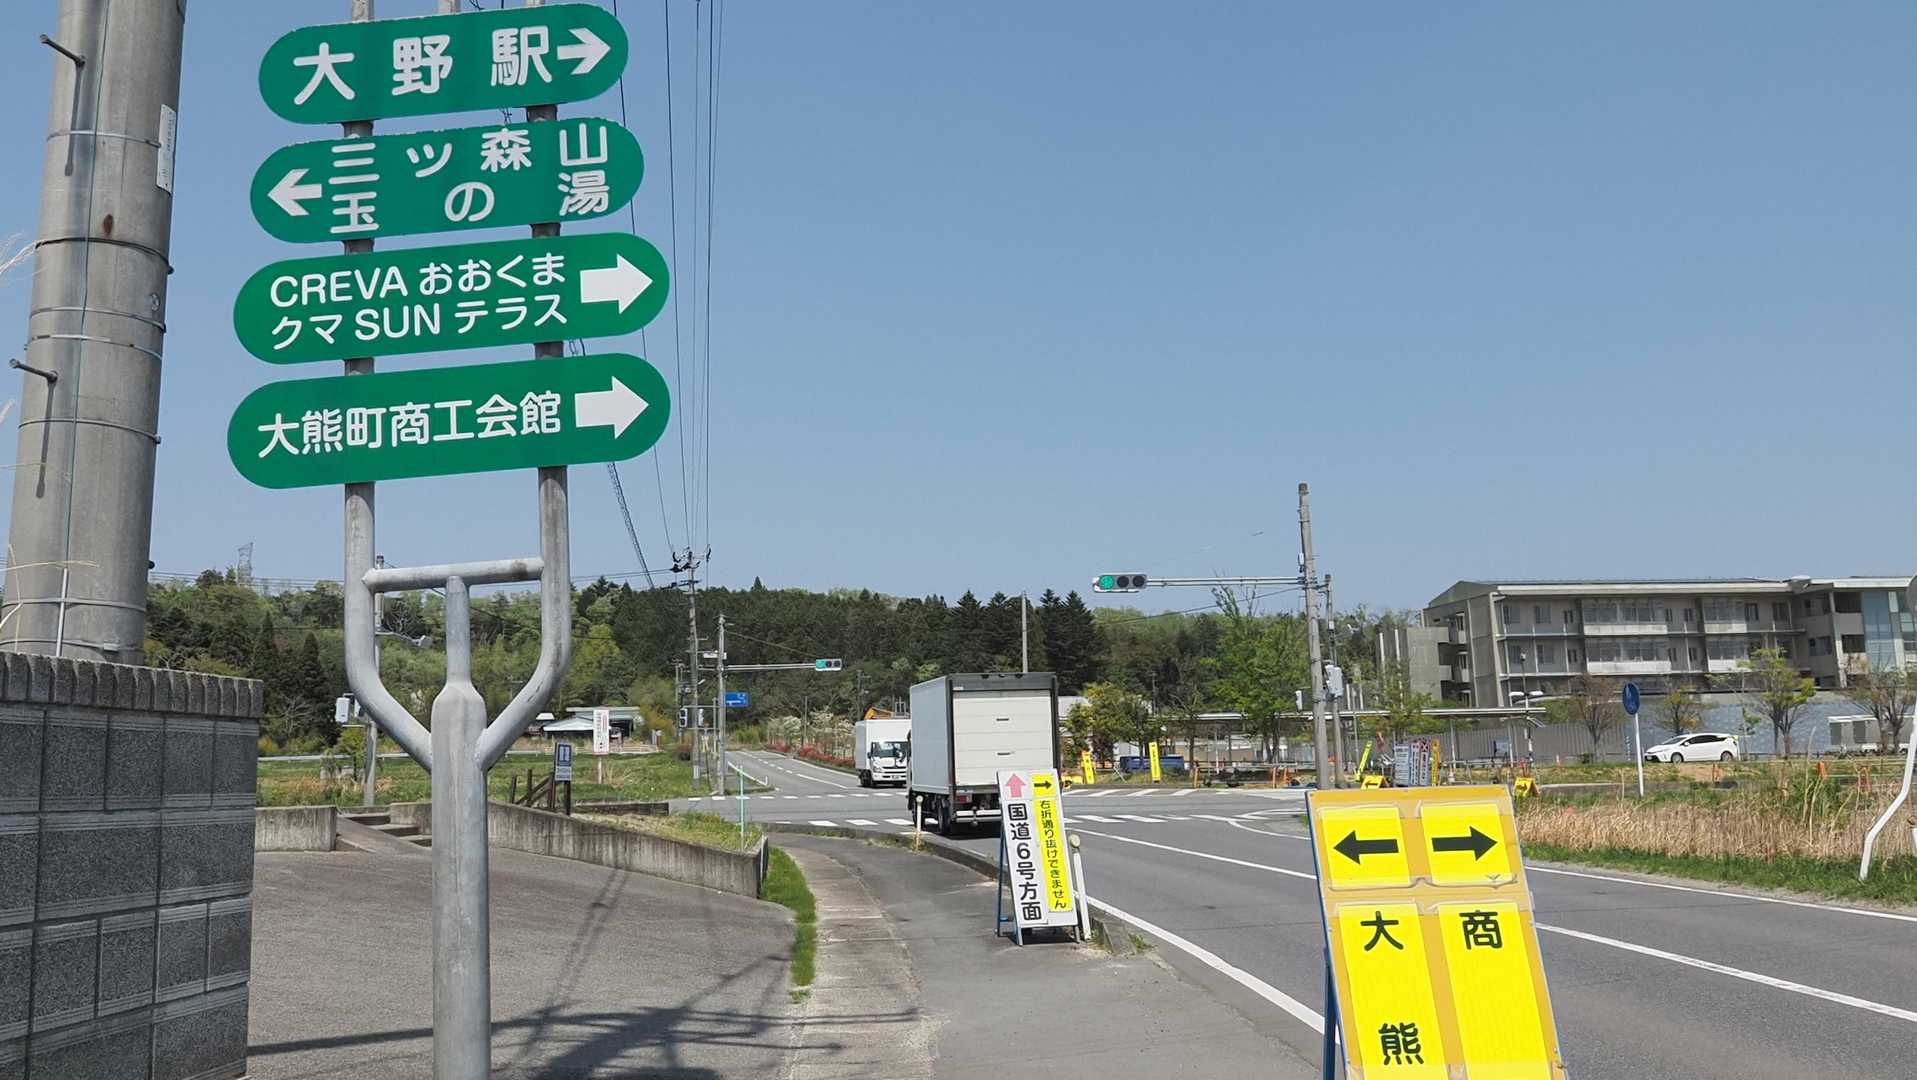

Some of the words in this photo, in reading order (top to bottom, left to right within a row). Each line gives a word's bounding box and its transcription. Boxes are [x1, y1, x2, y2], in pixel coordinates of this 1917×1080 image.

[293, 26, 552, 106] 大野駅
[328, 123, 609, 185] 三ツ森山
[330, 172, 610, 234] 玉の湯
[270, 266, 409, 308] CREVA
[419, 253, 566, 295] おおくま
[271, 313, 344, 351] クマ
[354, 303, 441, 339] SUN
[454, 294, 568, 334] テラス
[258, 391, 562, 459] 大熊町商工会館
[1008, 803, 1042, 921] 国道6号方面
[1040, 800, 1067, 909] 右折通り抜けできません
